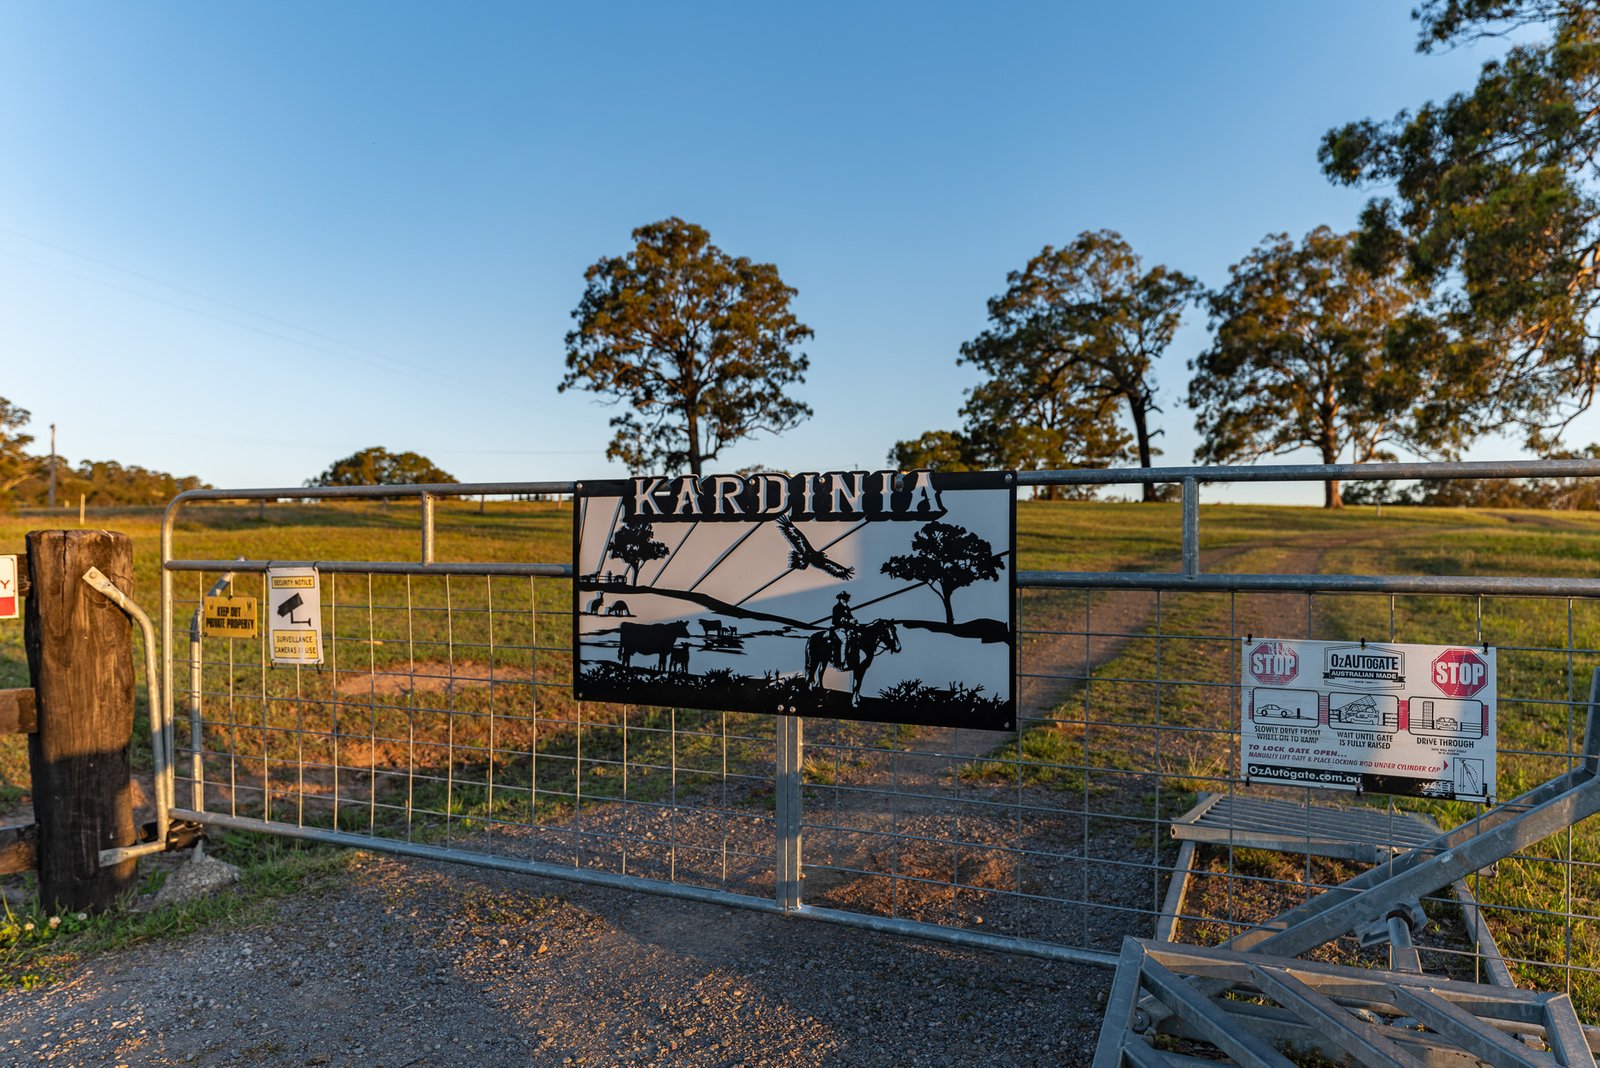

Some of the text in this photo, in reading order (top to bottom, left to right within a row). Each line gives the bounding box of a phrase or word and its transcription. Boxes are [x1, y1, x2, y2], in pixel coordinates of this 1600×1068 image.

[633, 471, 943, 516] KARDINIA
[217, 606, 241, 617] KEEP OUT
[206, 618, 254, 629] PRIVATE PROPERTY
[276, 635, 313, 643] SURVEILLANCE
[275, 646, 297, 654] CAMERAS
[1253, 653, 1296, 675] STOP
[1331, 670, 1374, 678] AUSTRALIAN
[1436, 662, 1484, 686] STOP
[1254, 725, 1279, 733] SLOWLY
[1280, 727, 1299, 735] DRIVE
[1256, 733, 1278, 741] WHEEL
[1377, 734, 1393, 742] GATE
[1416, 737, 1474, 748] DRIVE THROUGH
[1347, 740, 1366, 748] FULLY
[1367, 741, 1391, 749] RAISED
[1248, 751, 1278, 759] MANUALLY
[1332, 758, 1358, 766] LOCKING
[1397, 763, 1427, 772] CYLINDER
[1249, 765, 1361, 783] OzAutogate.com.au
